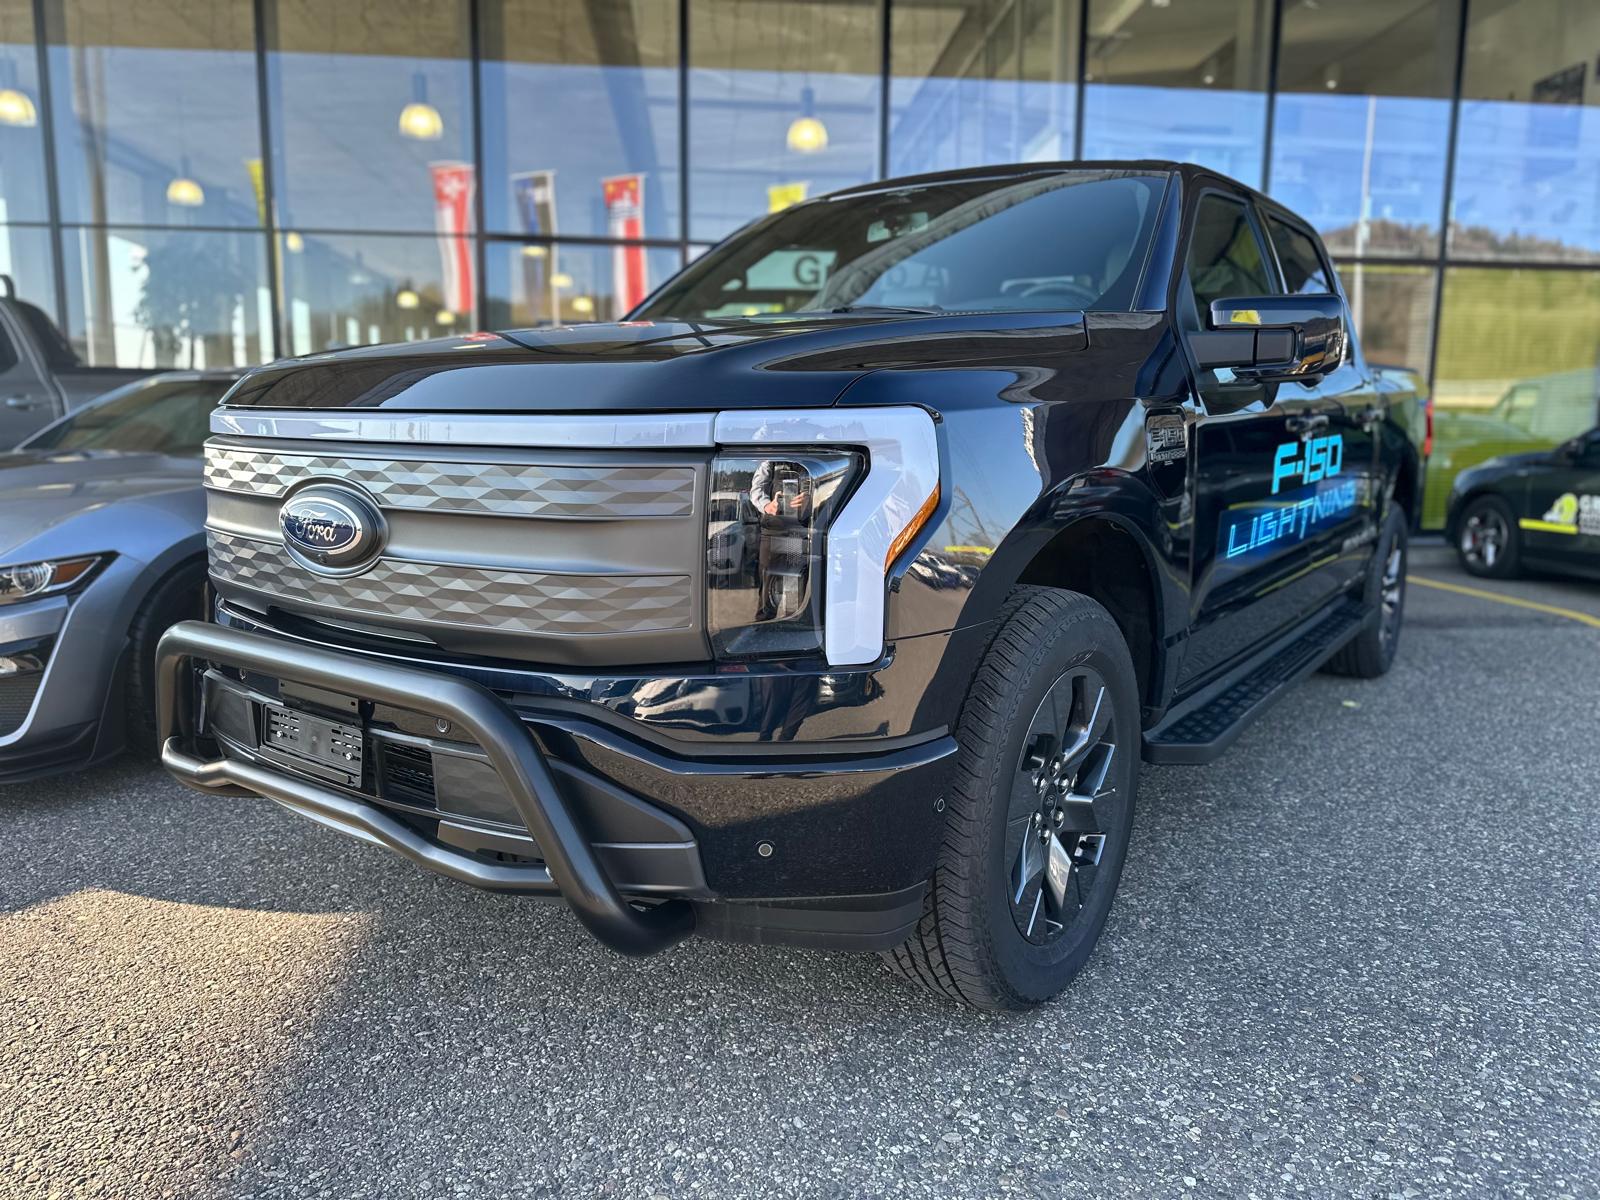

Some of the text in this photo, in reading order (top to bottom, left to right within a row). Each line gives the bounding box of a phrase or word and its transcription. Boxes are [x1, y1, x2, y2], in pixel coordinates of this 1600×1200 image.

[1271, 434, 1343, 494] F-150
[295, 508, 337, 542] Ford
[1226, 480, 1356, 559] LIGHTNING
